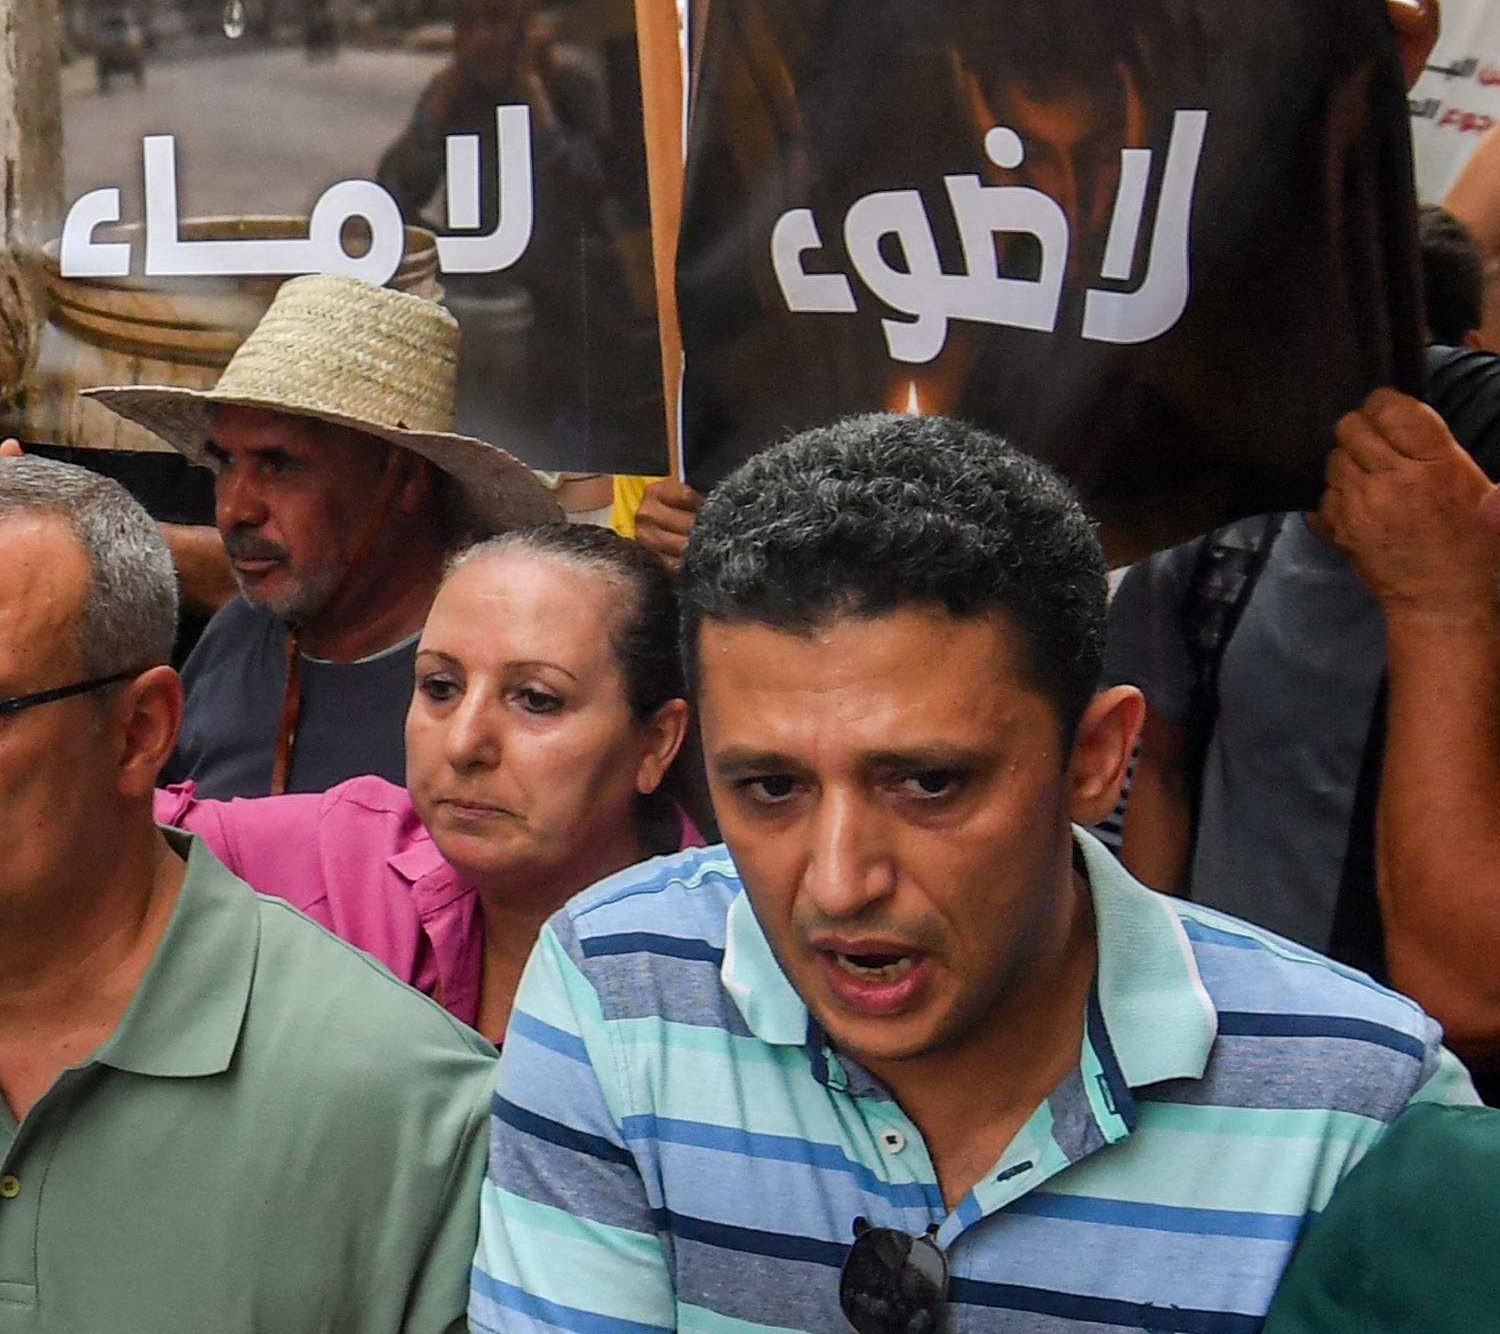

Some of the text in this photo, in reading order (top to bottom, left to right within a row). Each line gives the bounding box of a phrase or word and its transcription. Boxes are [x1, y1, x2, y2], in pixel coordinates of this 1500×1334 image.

[435, 104, 533, 274] لا
[771, 110, 1208, 364] لا ضوء
